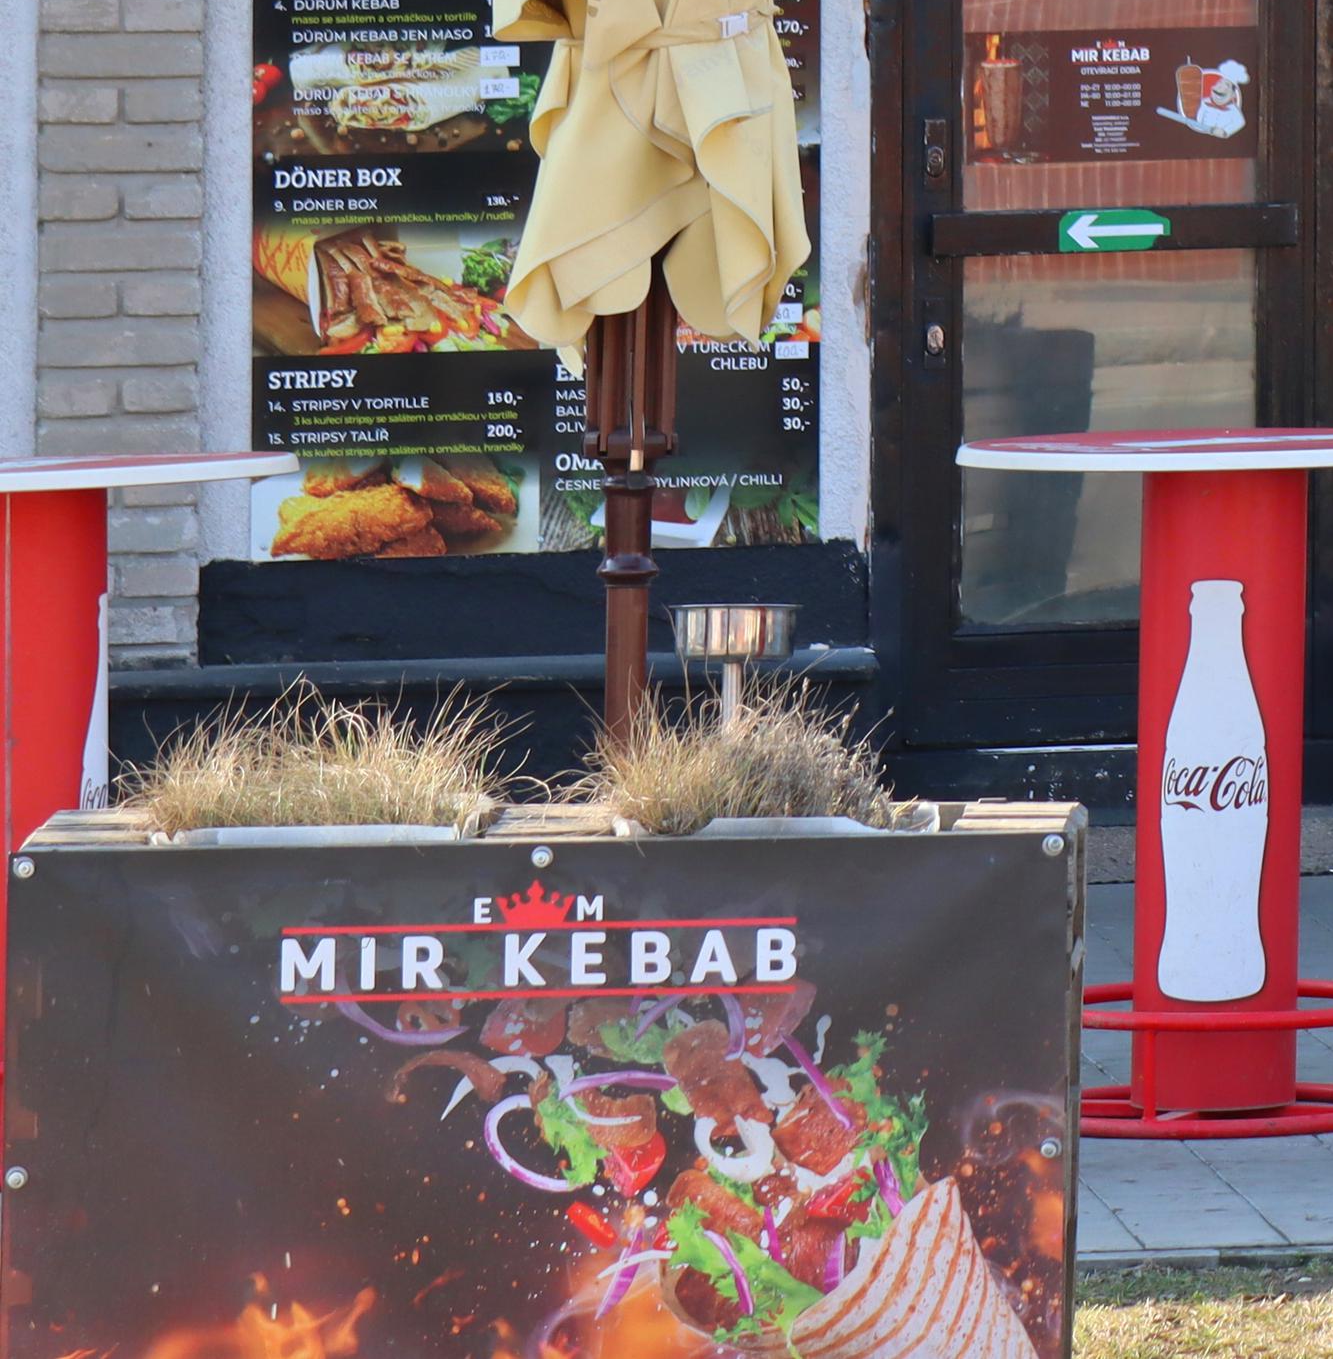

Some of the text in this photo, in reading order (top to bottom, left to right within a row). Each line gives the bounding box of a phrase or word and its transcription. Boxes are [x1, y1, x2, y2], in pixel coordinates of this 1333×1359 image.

[274, 1, 287, 11] 4.
[1072, 48, 1150, 62] MIR KEBAB
[275, 166, 402, 189] DÖNER BOX
[274, 201, 285, 211] 9.
[294, 197, 344, 212] DÖNER
[348, 199, 378, 210] BOX
[269, 369, 357, 390] STRIPSY
[782, 378, 809, 391] 50,-
[269, 401, 285, 412] 14.
[292, 400, 349, 412] STRIPSY
[352, 400, 361, 410] V
[366, 397, 429, 410] TORTILLE
[784, 417, 810, 431] 30,-
[269, 425, 522, 445] 15. STRIPSY TALÍŘ 200,-
[1164, 756, 1265, 813] Coca-Cola
[473, 896, 603, 924] E M
[504, 928, 797, 987] KEBAB
